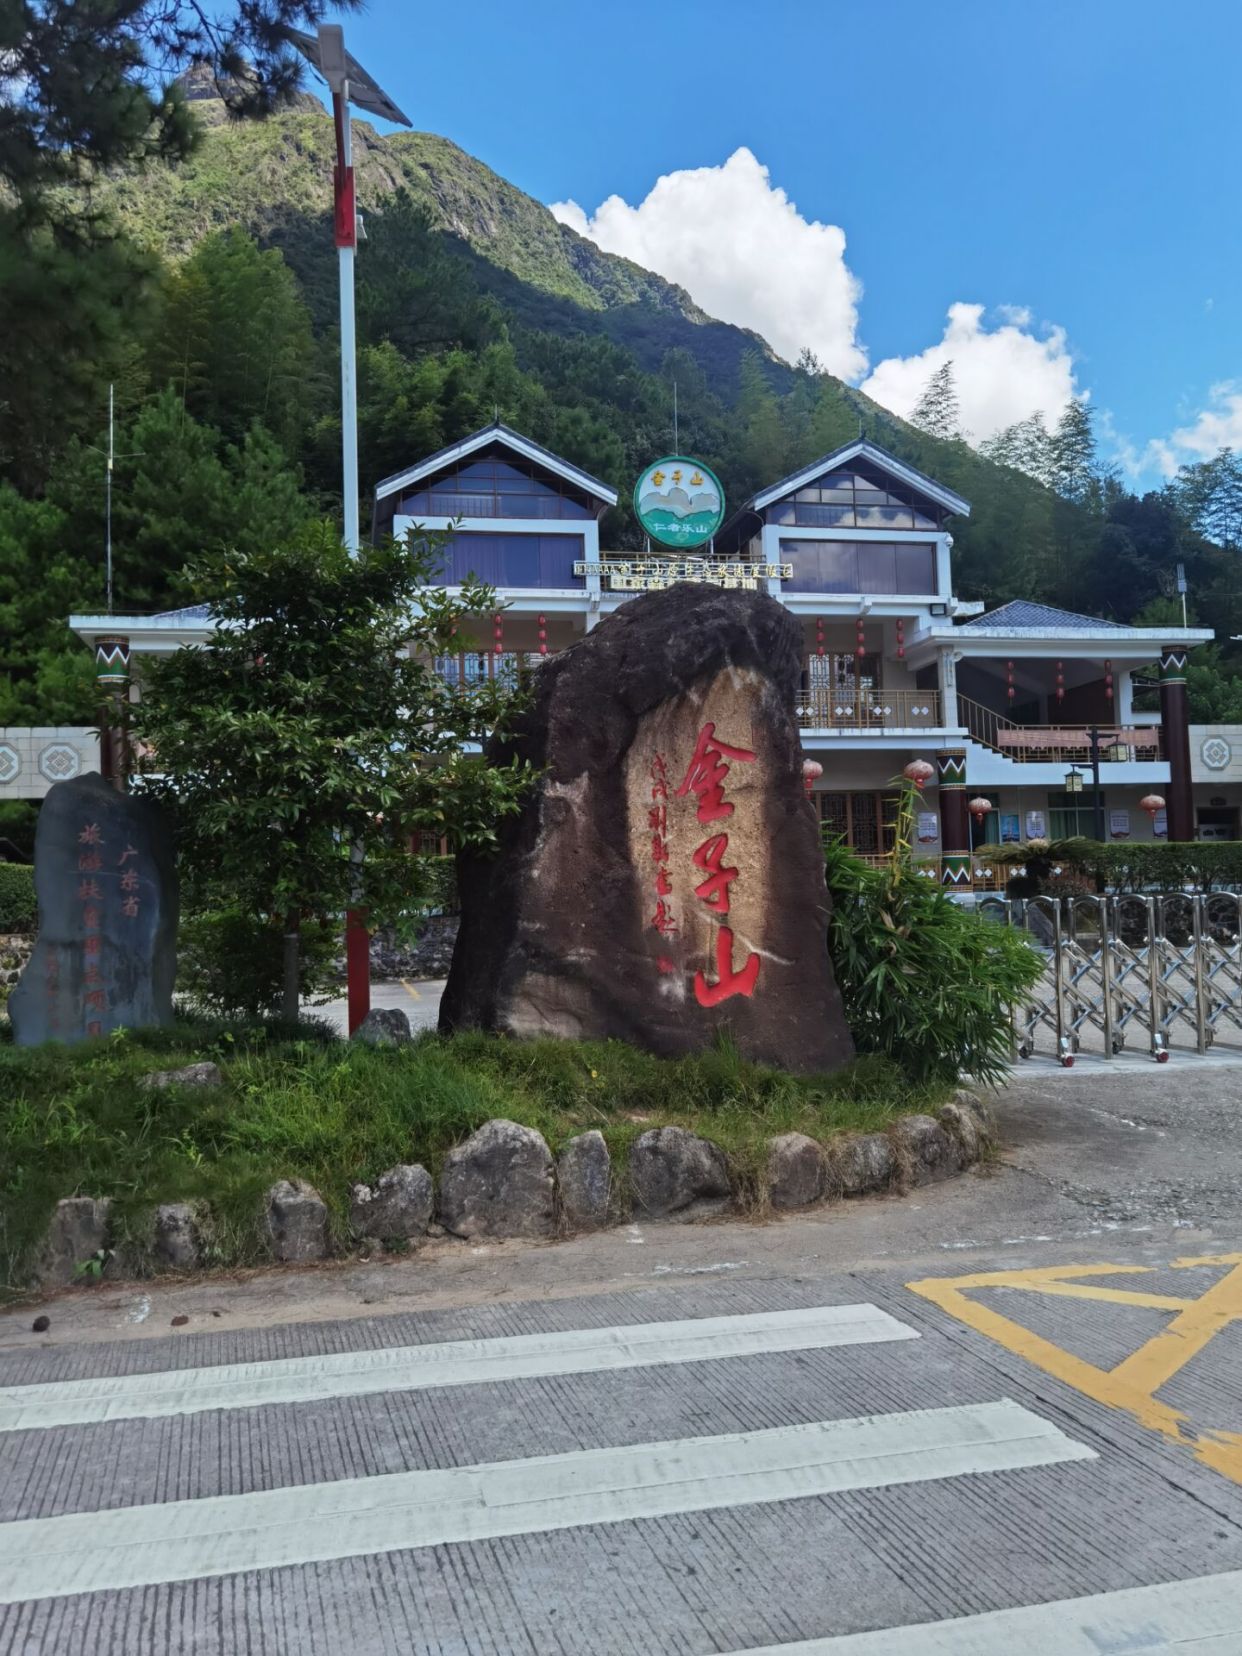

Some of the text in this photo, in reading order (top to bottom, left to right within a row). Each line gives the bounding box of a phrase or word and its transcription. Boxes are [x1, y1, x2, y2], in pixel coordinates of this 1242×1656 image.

[650, 469, 705, 486] 金子山
[653, 522, 708, 533] 仁者乐山
[118, 846, 140, 916] 广东省
[676, 722, 760, 1007] 金子山
